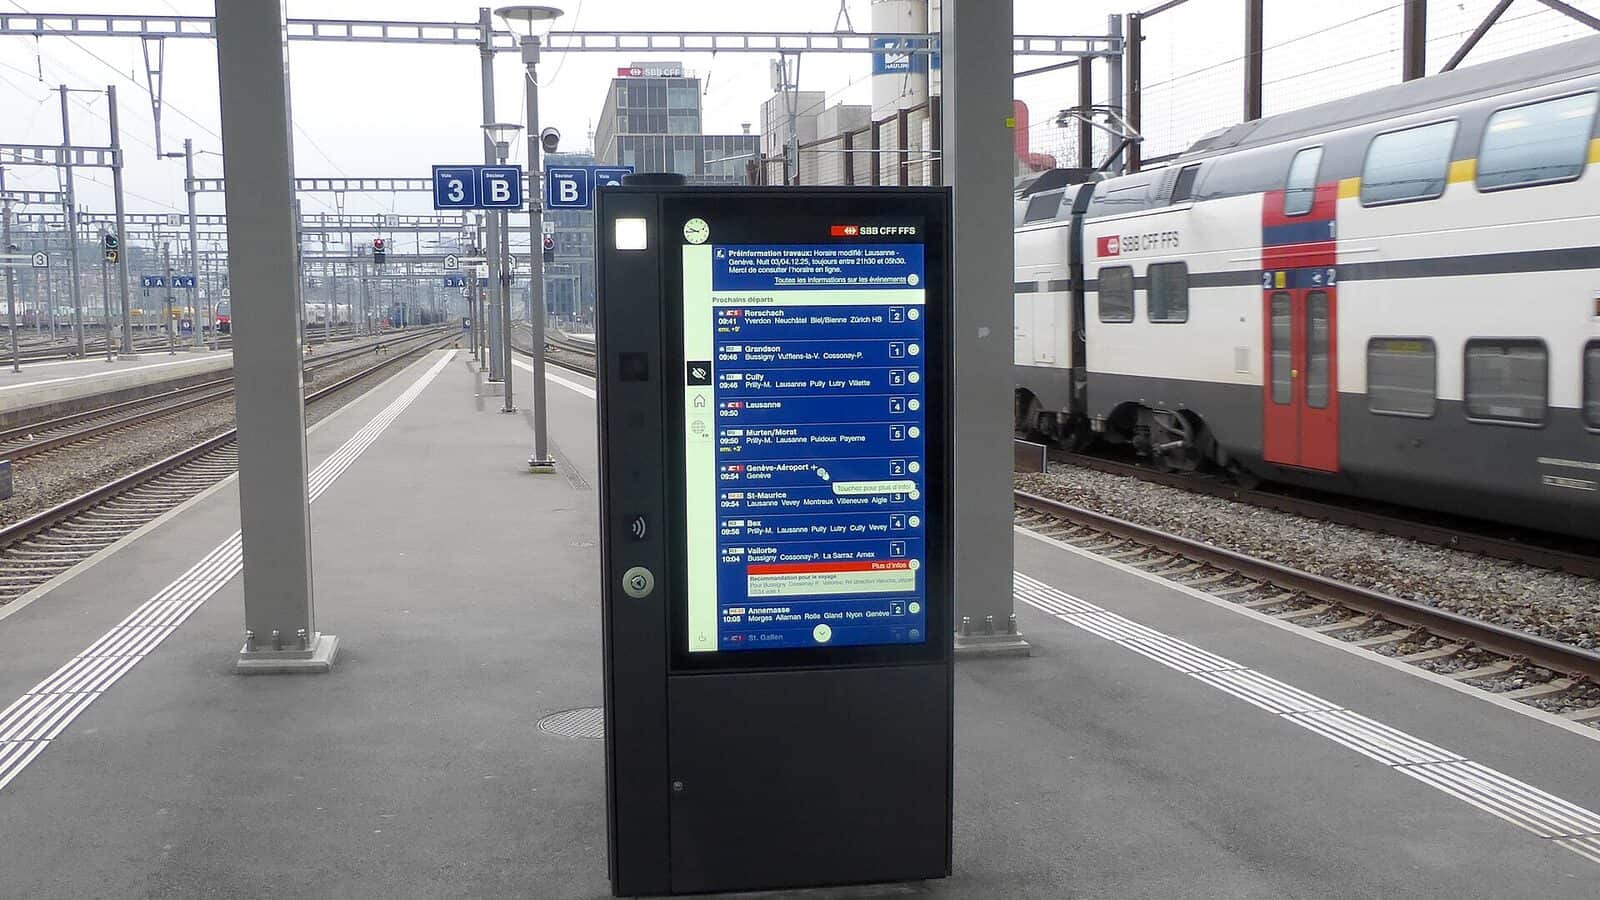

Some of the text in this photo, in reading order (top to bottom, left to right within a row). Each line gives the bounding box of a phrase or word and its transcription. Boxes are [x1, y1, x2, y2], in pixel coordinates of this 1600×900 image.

[448, 179, 464, 202] 3
[491, 180, 510, 202] B
[560, 180, 579, 202] B
[859, 227, 916, 235] SBB CFF FFS
[1327, 220, 1336, 238] 1
[1122, 231, 1179, 252] SBB CFF FFS
[728, 249, 782, 257] Préinformation
[813, 249, 836, 257] Horaire
[864, 249, 895, 257] Lausanne
[36, 254, 44, 266] 3
[447, 257, 455, 267] 3
[812, 258, 838, 266] toujours
[774, 276, 796, 284] Toutes
[797, 276, 806, 284] les
[807, 275, 846, 284] informations
[858, 275, 868, 283] les
[1263, 272, 1272, 289] 2
[1327, 268, 1336, 286] 2
[712, 296, 774, 304] Prochains départs
[744, 309, 784, 317] Rorschach
[893, 312, 901, 320] 2
[718, 318, 737, 326] 09:41
[744, 317, 772, 325] Yverdon
[810, 316, 847, 325] Biel/Bienne
[744, 345, 781, 353] Grandson
[744, 353, 775, 362] Bussigny
[745, 373, 764, 381] Cully
[810, 380, 826, 389] Pully
[828, 380, 846, 388] Lutry
[745, 401, 781, 409] Lausanne
[746, 428, 797, 437] Murten/Morat
[894, 430, 901, 438] 5
[810, 435, 837, 443] Puidoux
[839, 435, 866, 443] Payerne
[746, 463, 809, 472] Genève-Aéroport
[894, 465, 901, 473] 2
[746, 491, 787, 499] St-Maurice
[781, 499, 800, 507] Vevey
[871, 496, 888, 504] Aigle
[746, 519, 762, 527] Bex
[894, 519, 901, 527] 4
[811, 525, 827, 533] Pully
[829, 525, 847, 533] Lutry
[849, 524, 866, 532] Cully
[868, 523, 888, 531] Vevey
[747, 546, 777, 554] Vallorbe
[747, 554, 777, 562] Bussigny
[832, 551, 853, 559] Sarraz
[748, 607, 790, 615] Annemasse
[894, 606, 901, 614] 2
[748, 615, 773, 623] Morges
[775, 613, 801, 621] Allaman
[823, 611, 843, 619] Gland
[845, 611, 863, 619] Nyon
[760, 633, 783, 641] Gallen
